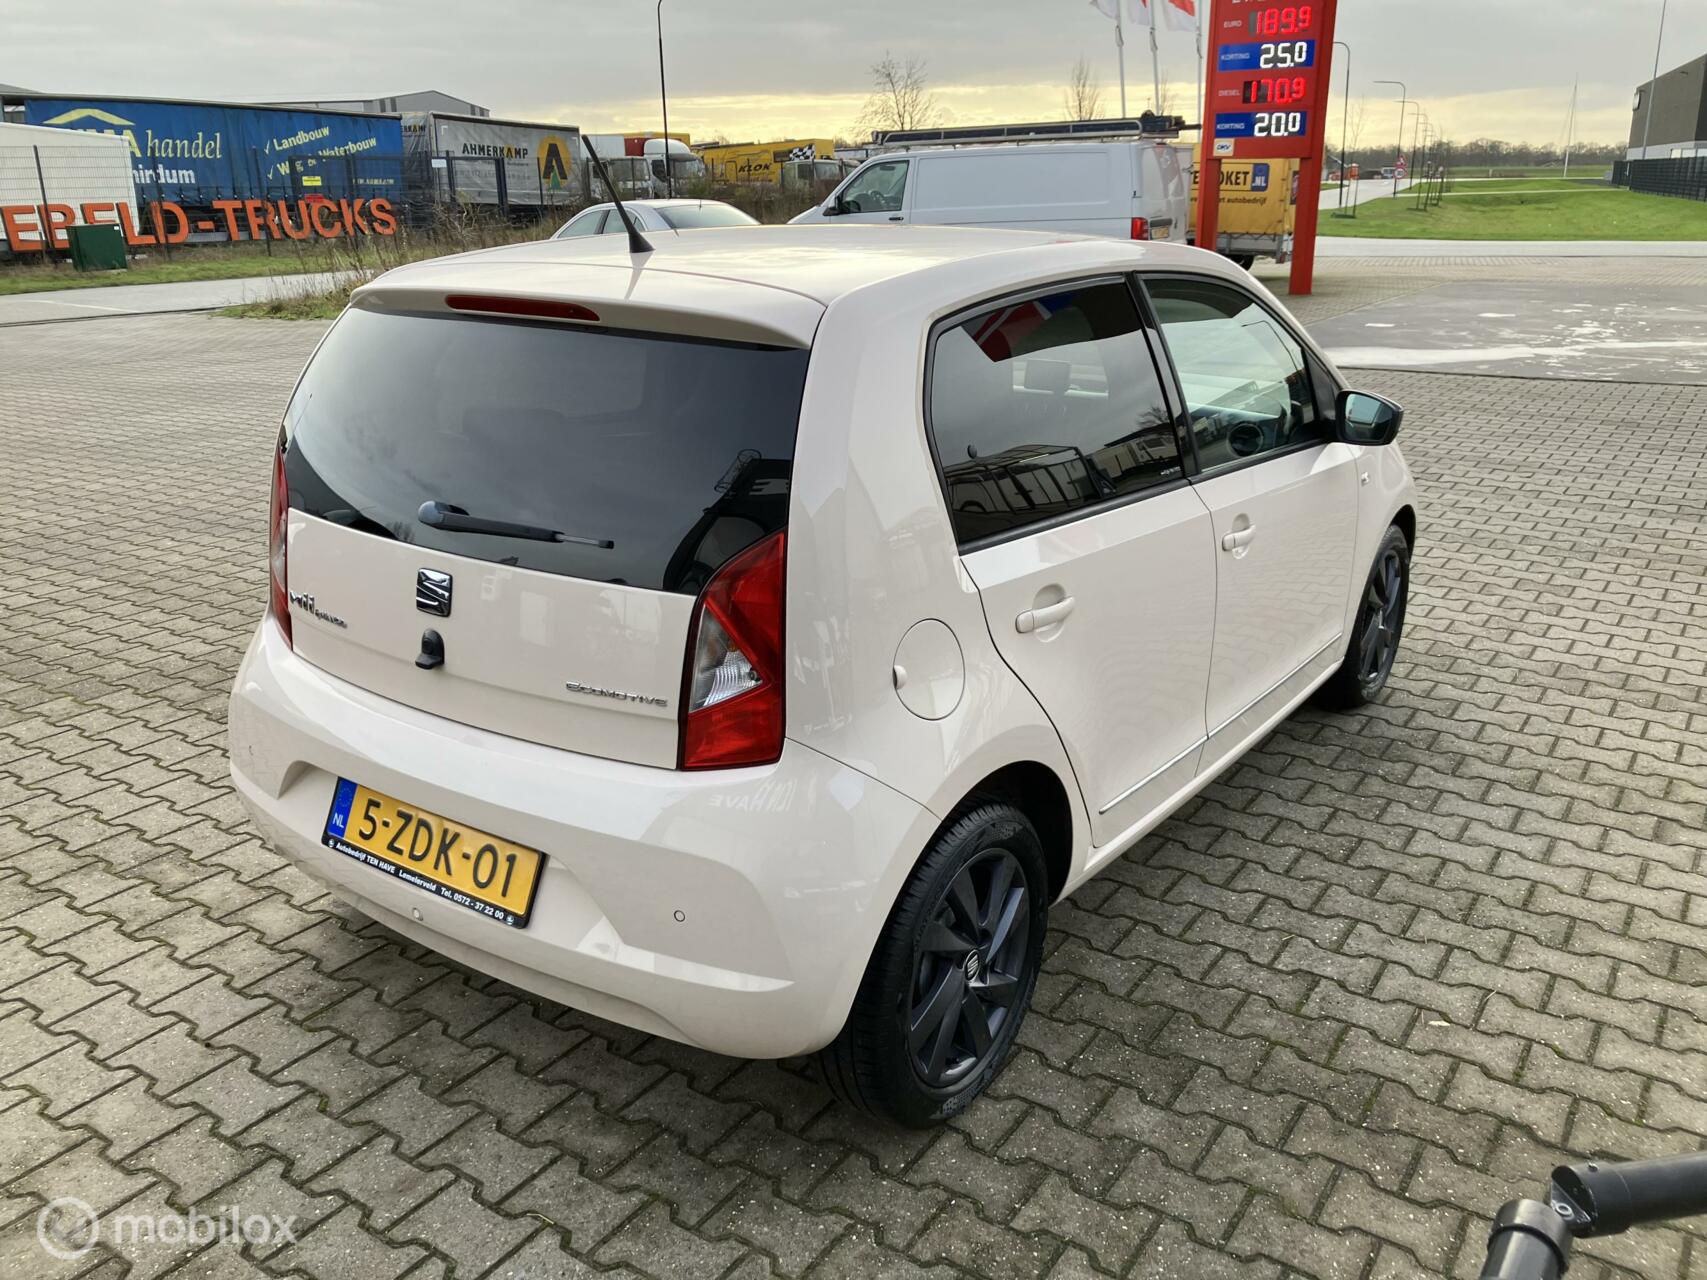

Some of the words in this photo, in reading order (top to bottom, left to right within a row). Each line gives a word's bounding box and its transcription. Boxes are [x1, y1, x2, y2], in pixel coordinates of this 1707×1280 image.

[1260, 41, 1308, 69] 25.0
[1218, 89, 1240, 97] DIESEL
[1254, 112, 1301, 137] 20.0
[146, 130, 222, 159] handel
[273, 126, 330, 151] Landbouw
[462, 142, 529, 160] AHMERKAMP
[332, 812, 345, 829] NL
[358, 798, 517, 898] 5-ZDK-01
[336, 843, 367, 861] Autobedrijf
[367, 855, 378, 867] TEN
[379, 861, 396, 873] HAVE
[453, 893, 471, 906] 0572
[475, 901, 484, 911] 37
[485, 906, 494, 916] 22
[494, 910, 504, 919] 00
